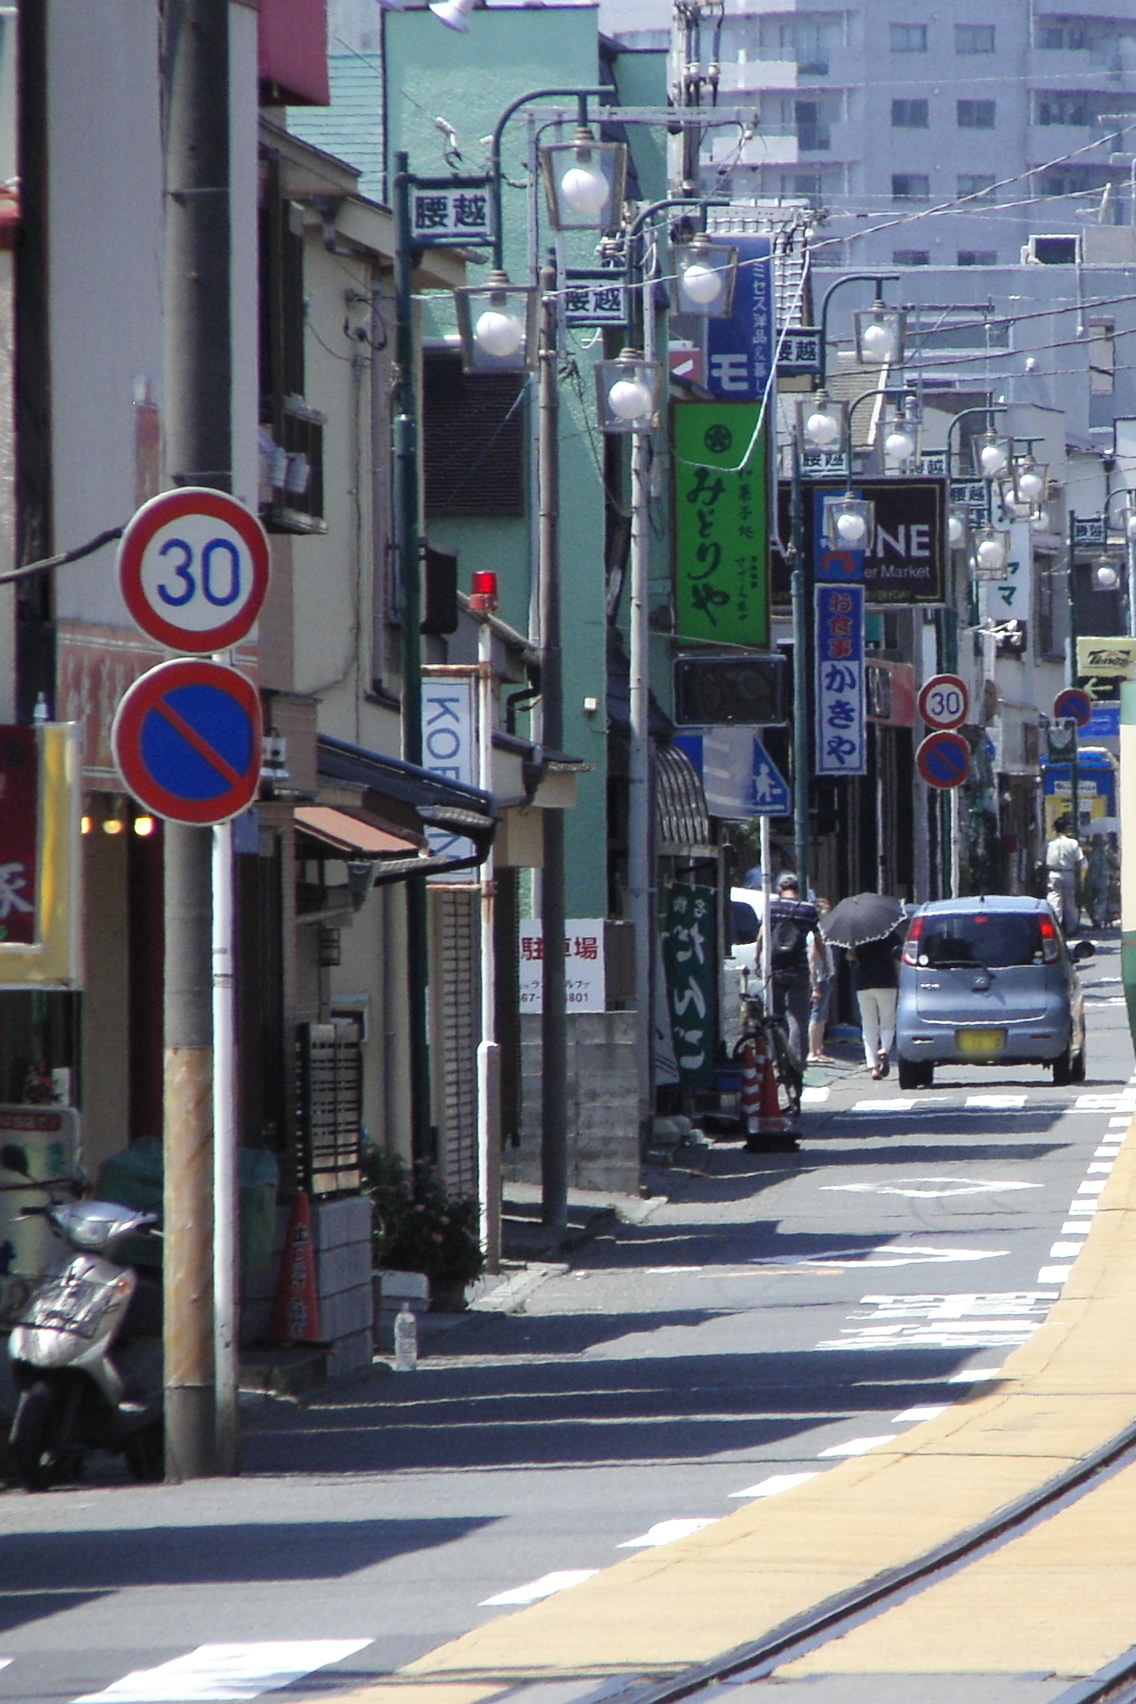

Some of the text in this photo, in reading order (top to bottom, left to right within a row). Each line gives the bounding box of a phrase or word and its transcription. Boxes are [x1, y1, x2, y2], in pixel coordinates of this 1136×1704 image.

[415, 194, 486, 229] 腰越
[565, 285, 621, 312] 腰越
[752, 263, 767, 399] ミセス洋品&暮し
[157, 538, 241, 607] 30
[687, 467, 731, 626] みどりや
[881, 565, 931, 578] Market
[828, 592, 853, 658] お食事
[825, 664, 857, 765] かきや
[931, 692, 960, 716] 30
